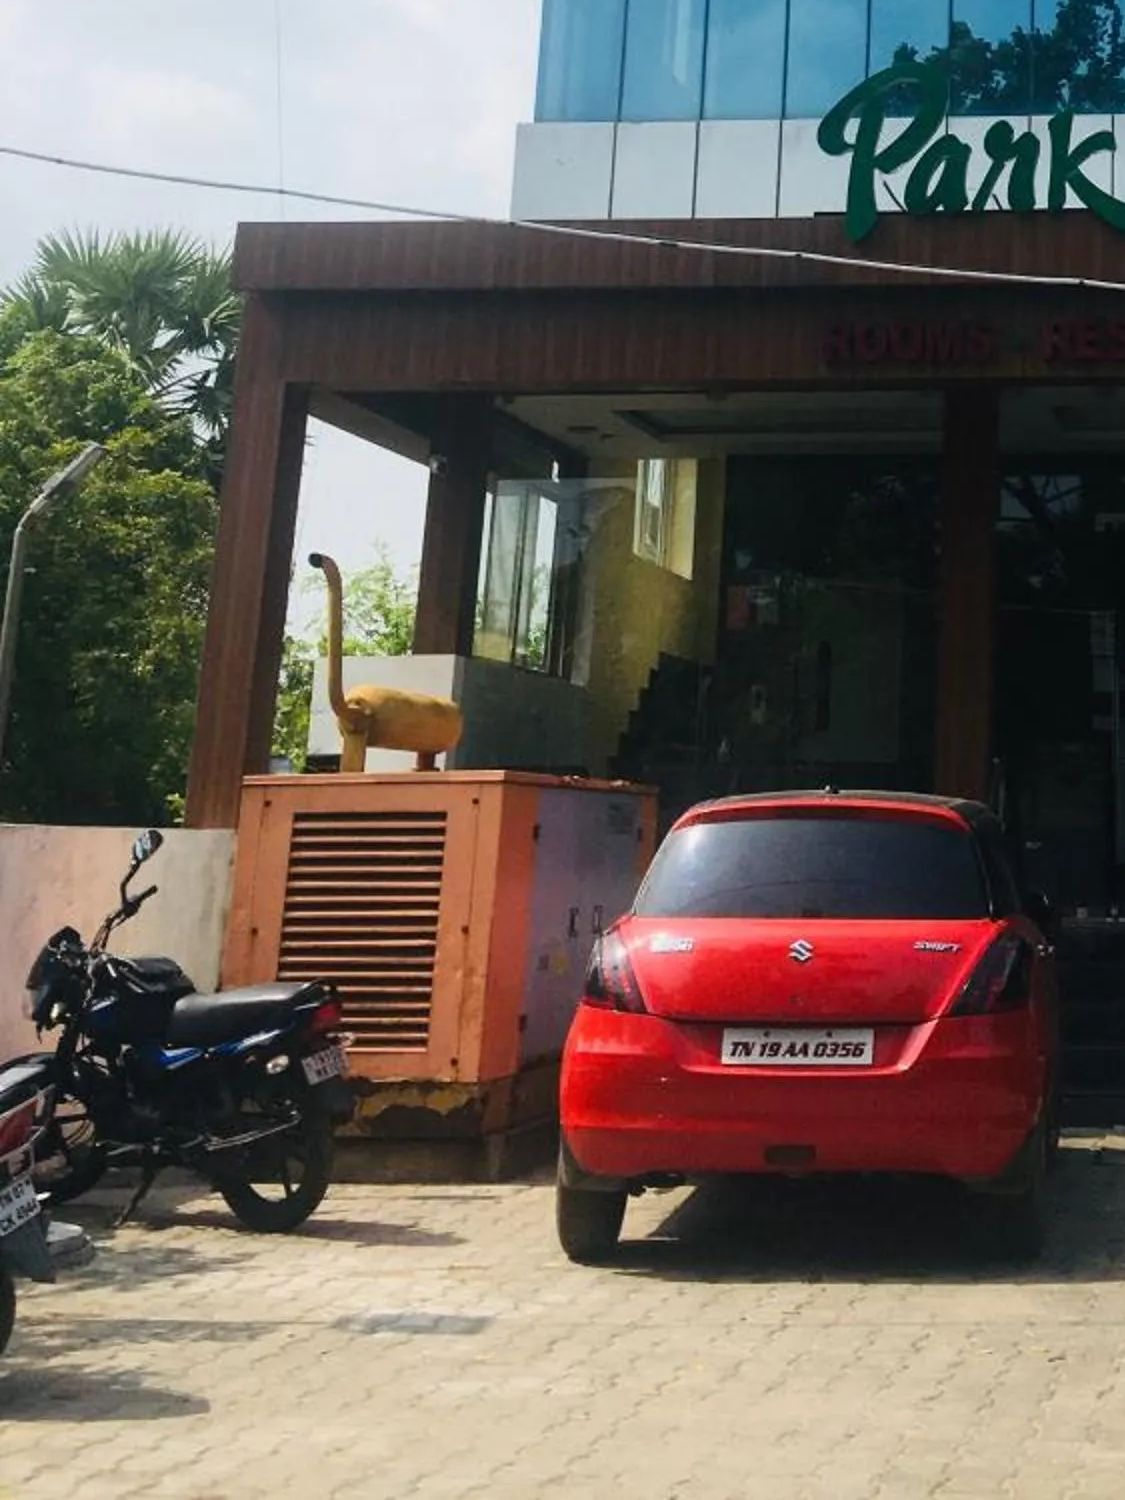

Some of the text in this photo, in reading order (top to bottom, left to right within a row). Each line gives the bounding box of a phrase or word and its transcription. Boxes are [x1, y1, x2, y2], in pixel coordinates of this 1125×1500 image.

[818, 319, 996, 364] ROOMS
[730, 1041, 867, 1058] TN 19 AA 0356
